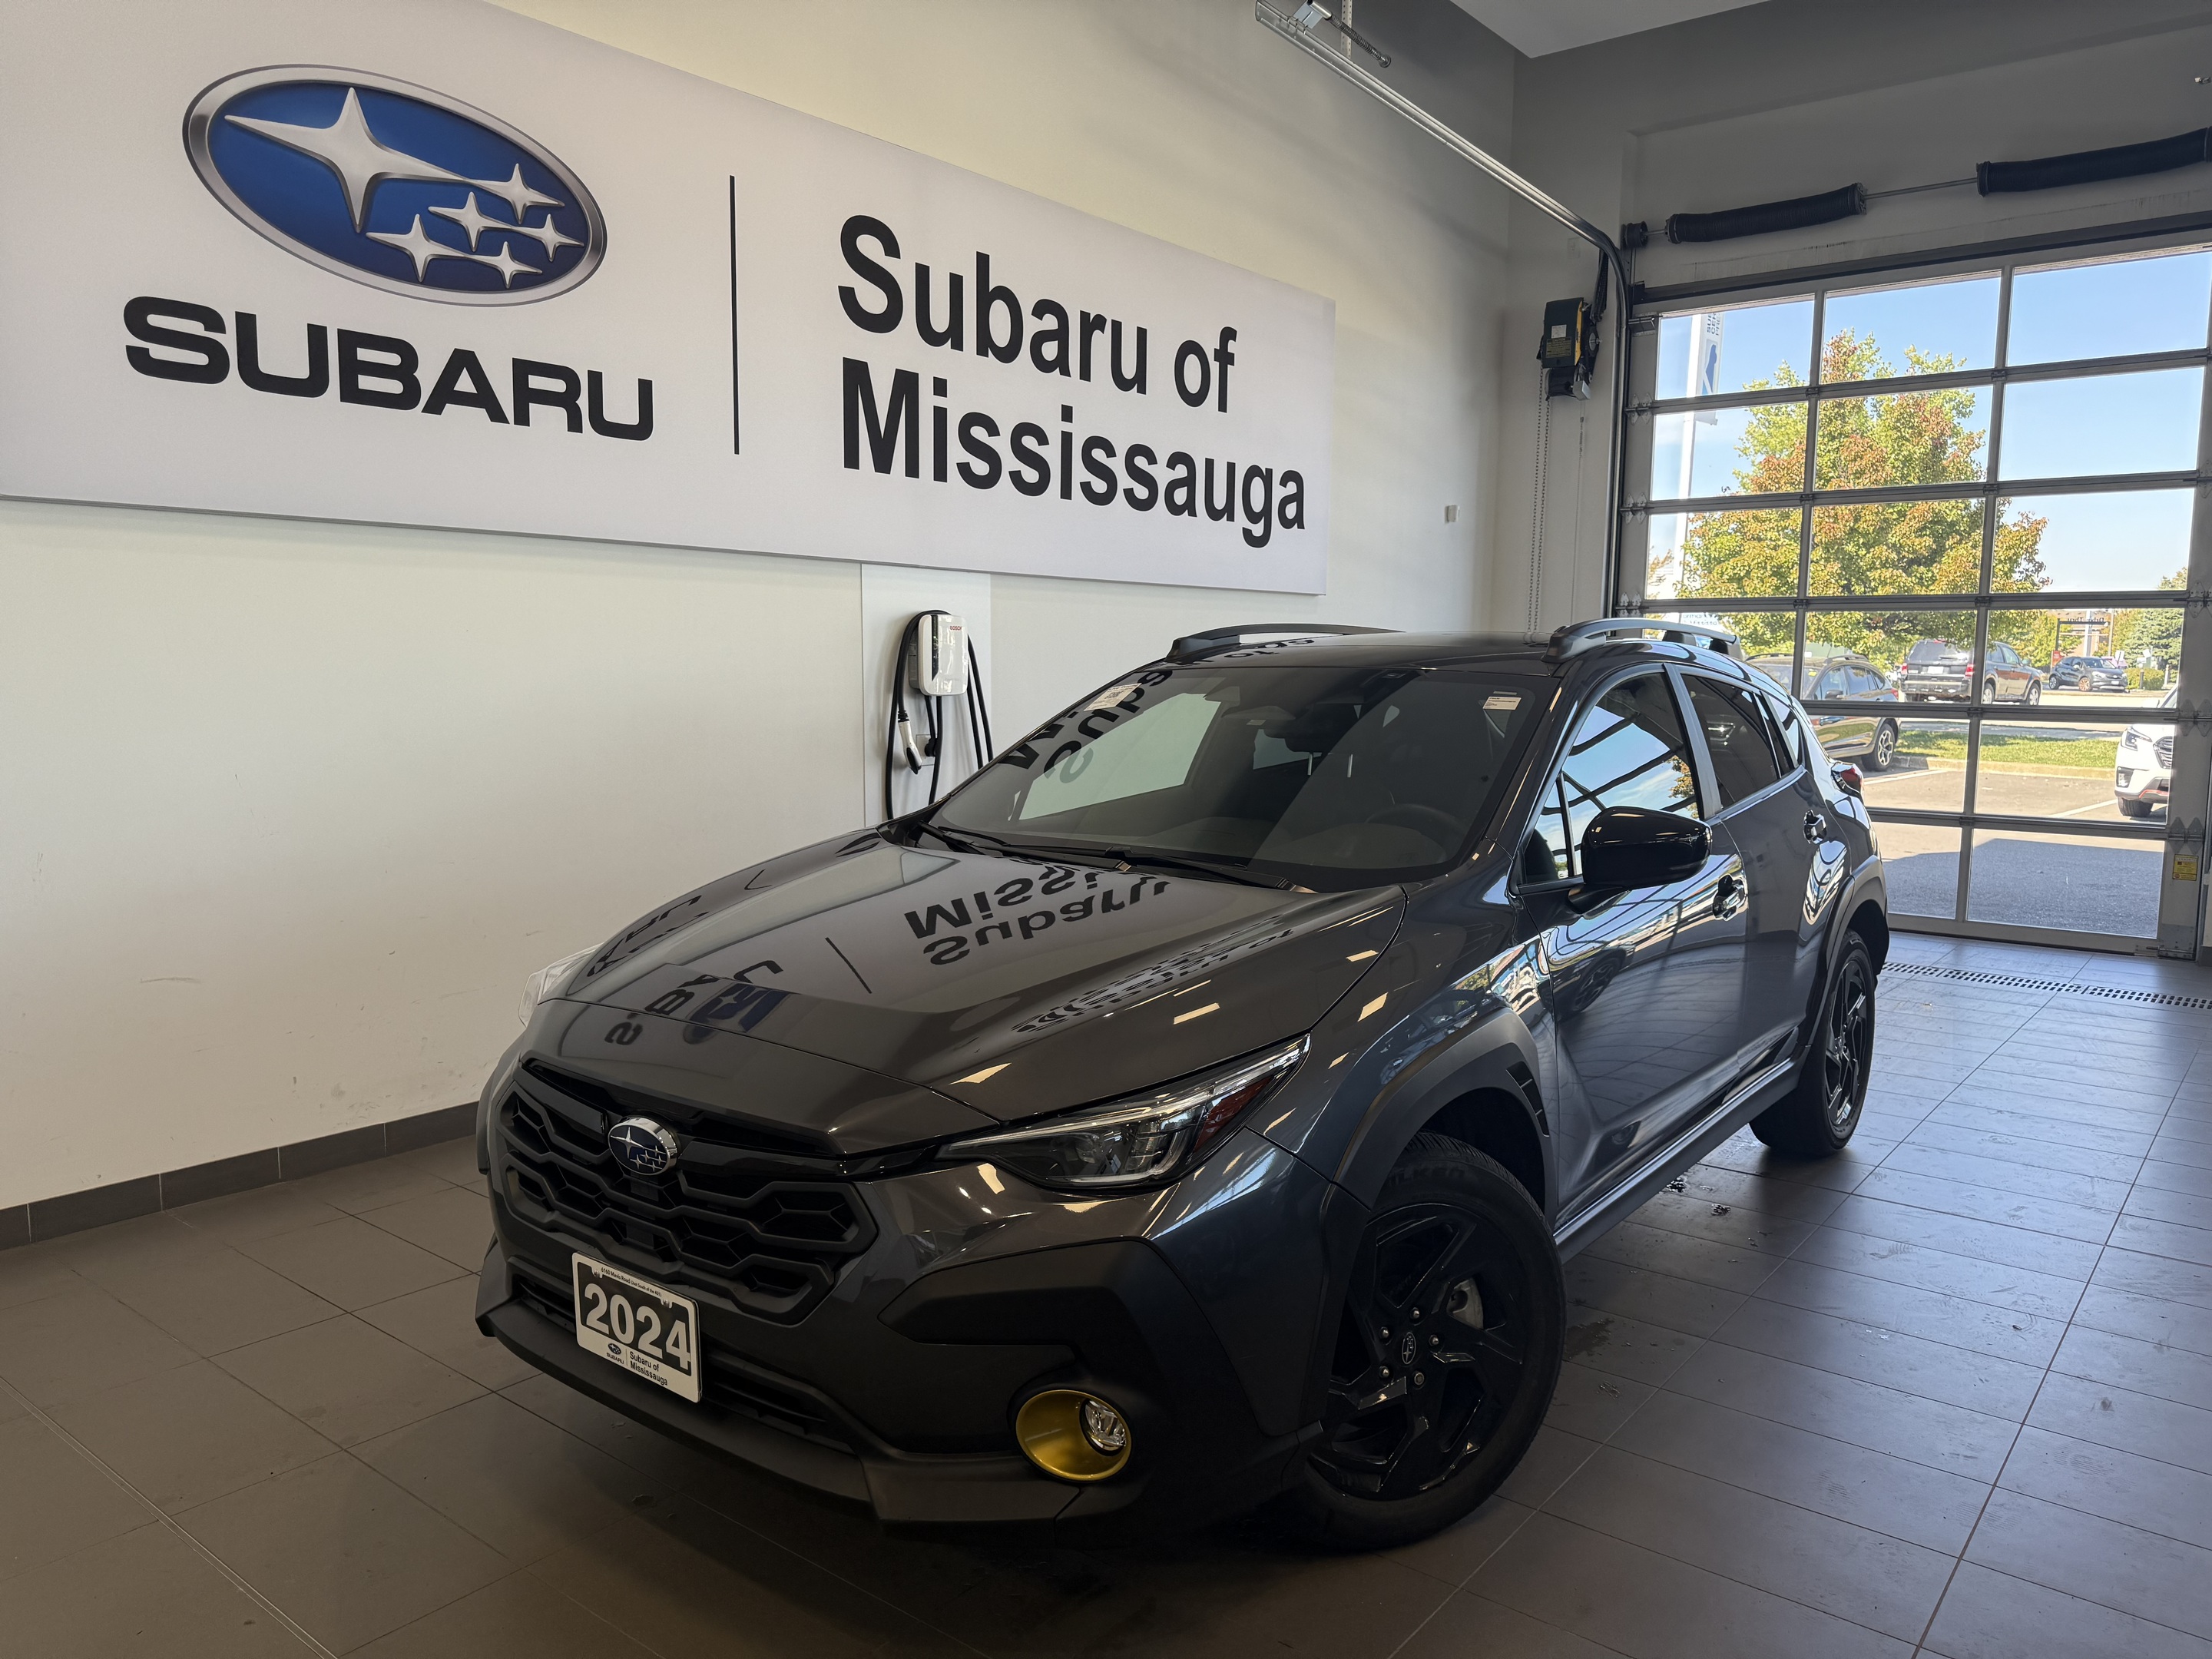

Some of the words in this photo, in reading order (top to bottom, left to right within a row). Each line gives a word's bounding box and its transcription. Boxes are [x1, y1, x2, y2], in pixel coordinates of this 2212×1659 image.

[838, 215, 1147, 396] Subaru
[1174, 326, 1237, 413] of
[123, 296, 654, 441] SUBARU
[842, 356, 1305, 548] Mississauga
[611, 1271, 621, 1280] Mavis
[621, 1275, 631, 1283] Road
[584, 1283, 691, 1370] 2024
[606, 1352, 624, 1364] SUBARU
[630, 1351, 651, 1368] Subaru
[653, 1363, 660, 1372] of
[630, 1360, 668, 1386] Mississauga
